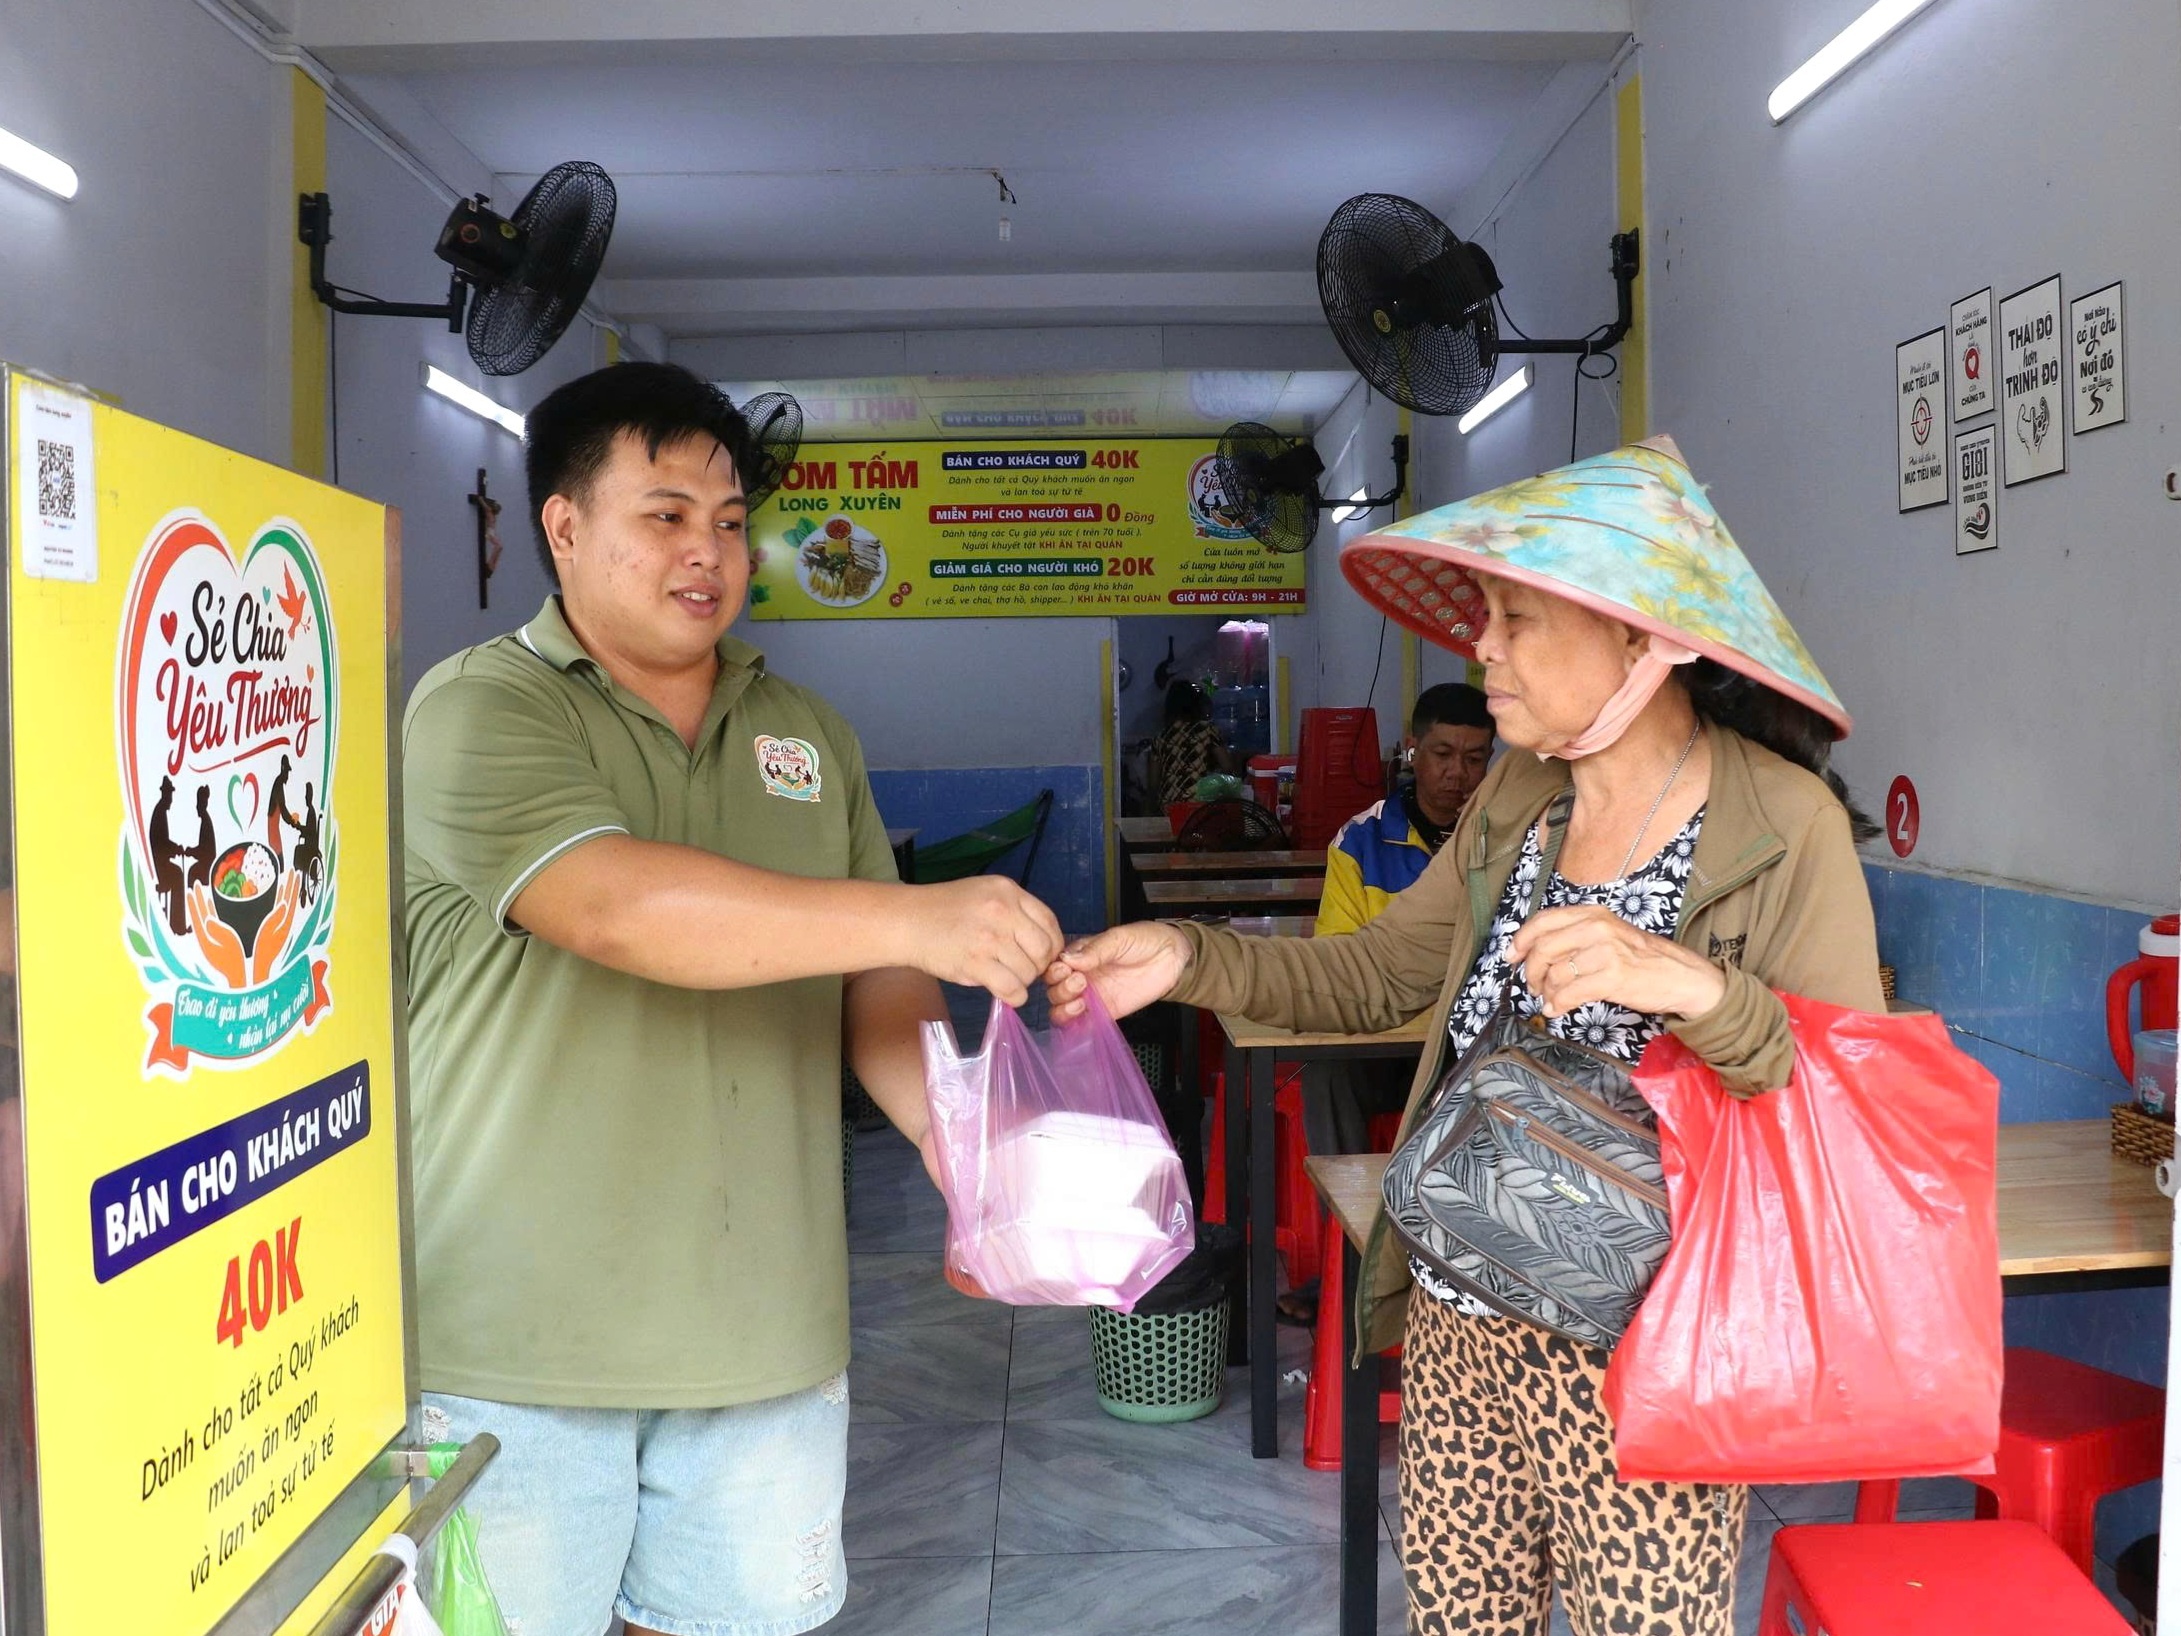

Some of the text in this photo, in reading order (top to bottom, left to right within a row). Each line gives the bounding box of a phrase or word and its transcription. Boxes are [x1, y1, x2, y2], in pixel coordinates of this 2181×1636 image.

[848, 450, 919, 490] TẤM
[946, 449, 1140, 469] BÁN CHO KHÁCH QUÝ 40K
[975, 475, 990, 485] cho
[1113, 475, 1135, 486] ngon
[779, 492, 901, 512] LONG XUYÊN
[936, 503, 1155, 526] MIỄN PHÍ CHO NGƯỜI GIÀ 0 Đồng
[1039, 540, 1056, 550] KHI
[1103, 528, 1114, 537] 70
[933, 556, 1156, 577] GIẢM GIÁ CHO NGƯỜI KHÓ 20K
[1077, 594, 1094, 604] KHI
[1251, 592, 1267, 602] 9H
[1278, 592, 1298, 602] 21H
[185, 580, 287, 667] Sẻ Chia
[156, 658, 322, 776] Yêu Thương
[1896, 792, 1909, 840] 2
[219, 999, 238, 1028] yêu
[105, 1076, 363, 1257] BÁN CHO KHÁCH QUÝ
[217, 1216, 304, 1350] 40K
[142, 1294, 359, 1502] Dành cho tất cả Quý khách
[208, 1390, 318, 1514] muốn ăn ngon
[190, 1418, 336, 1593] và lan toả sự tử tế
